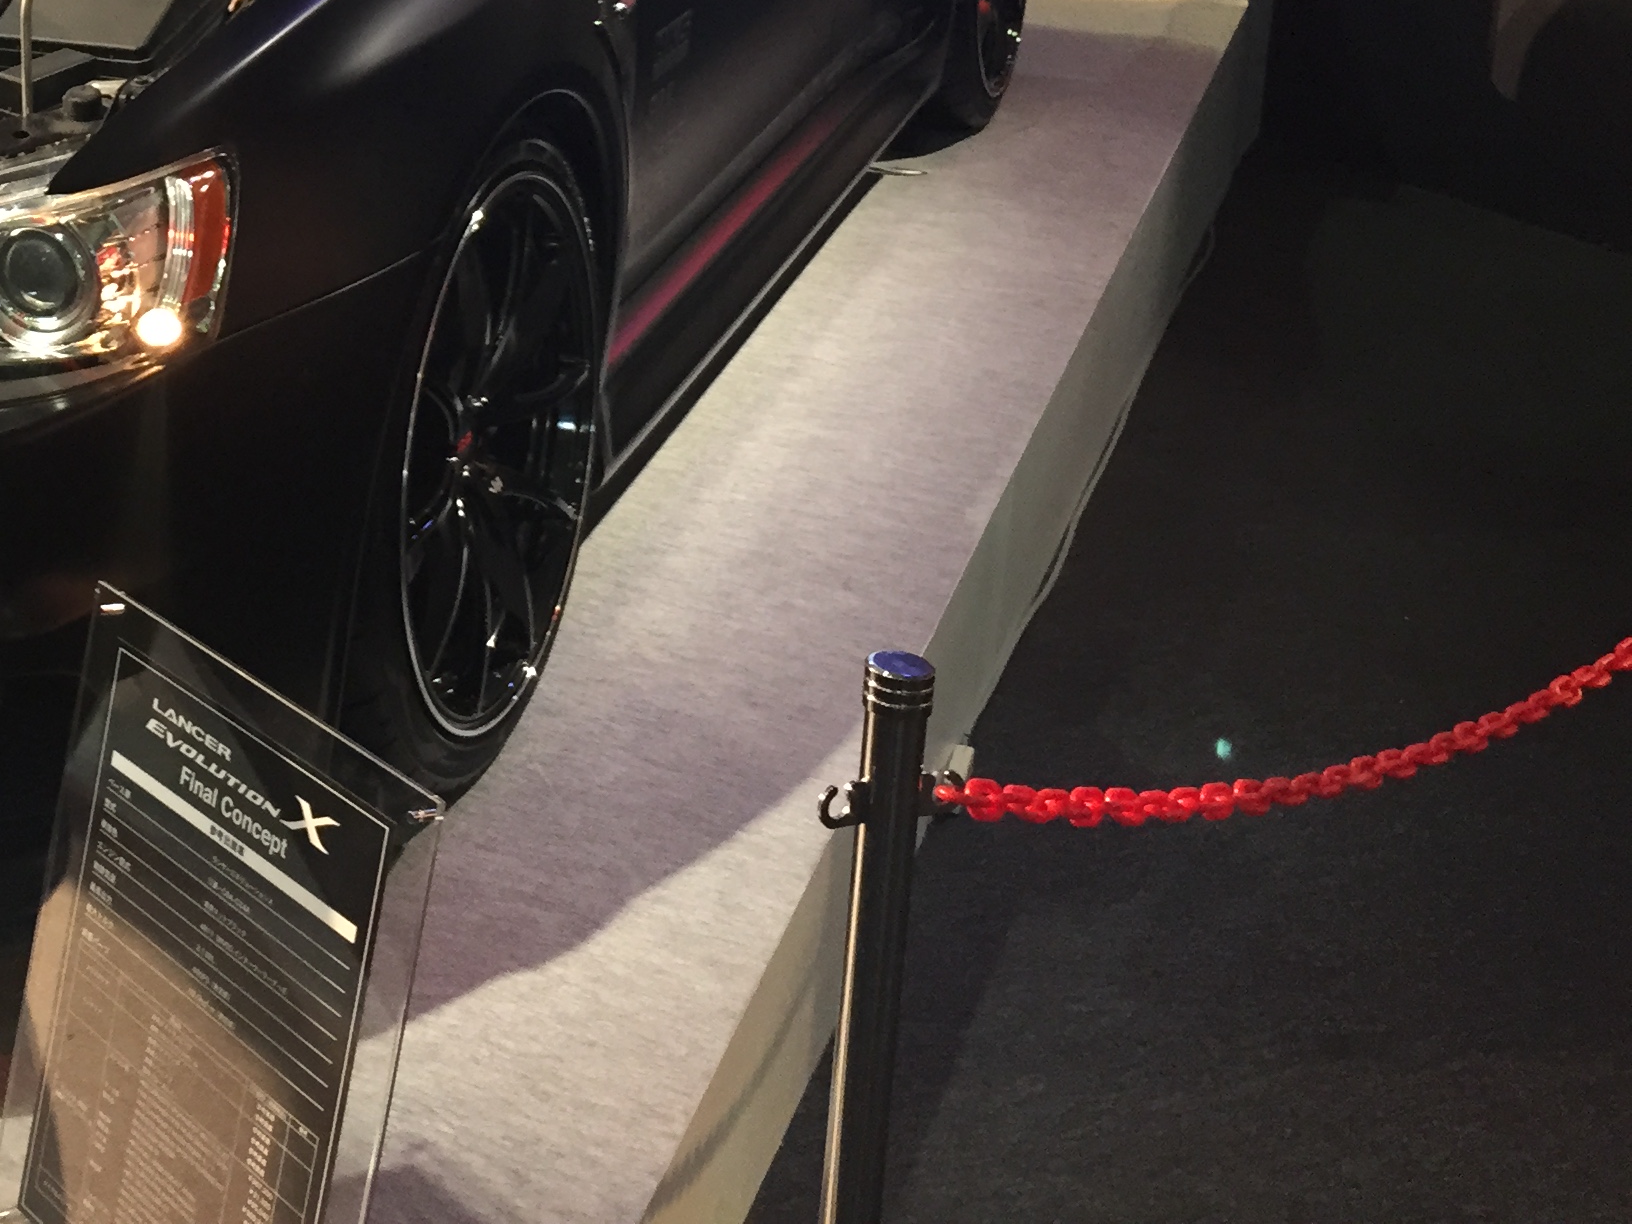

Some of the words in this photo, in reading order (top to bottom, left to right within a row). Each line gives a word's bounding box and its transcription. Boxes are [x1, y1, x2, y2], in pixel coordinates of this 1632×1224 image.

[152, 697, 232, 762] LANCER
[145, 717, 282, 819] EVOLUTION
[279, 794, 341, 856] X
[178, 764, 218, 809] Final
[220, 795, 289, 859] Concept
